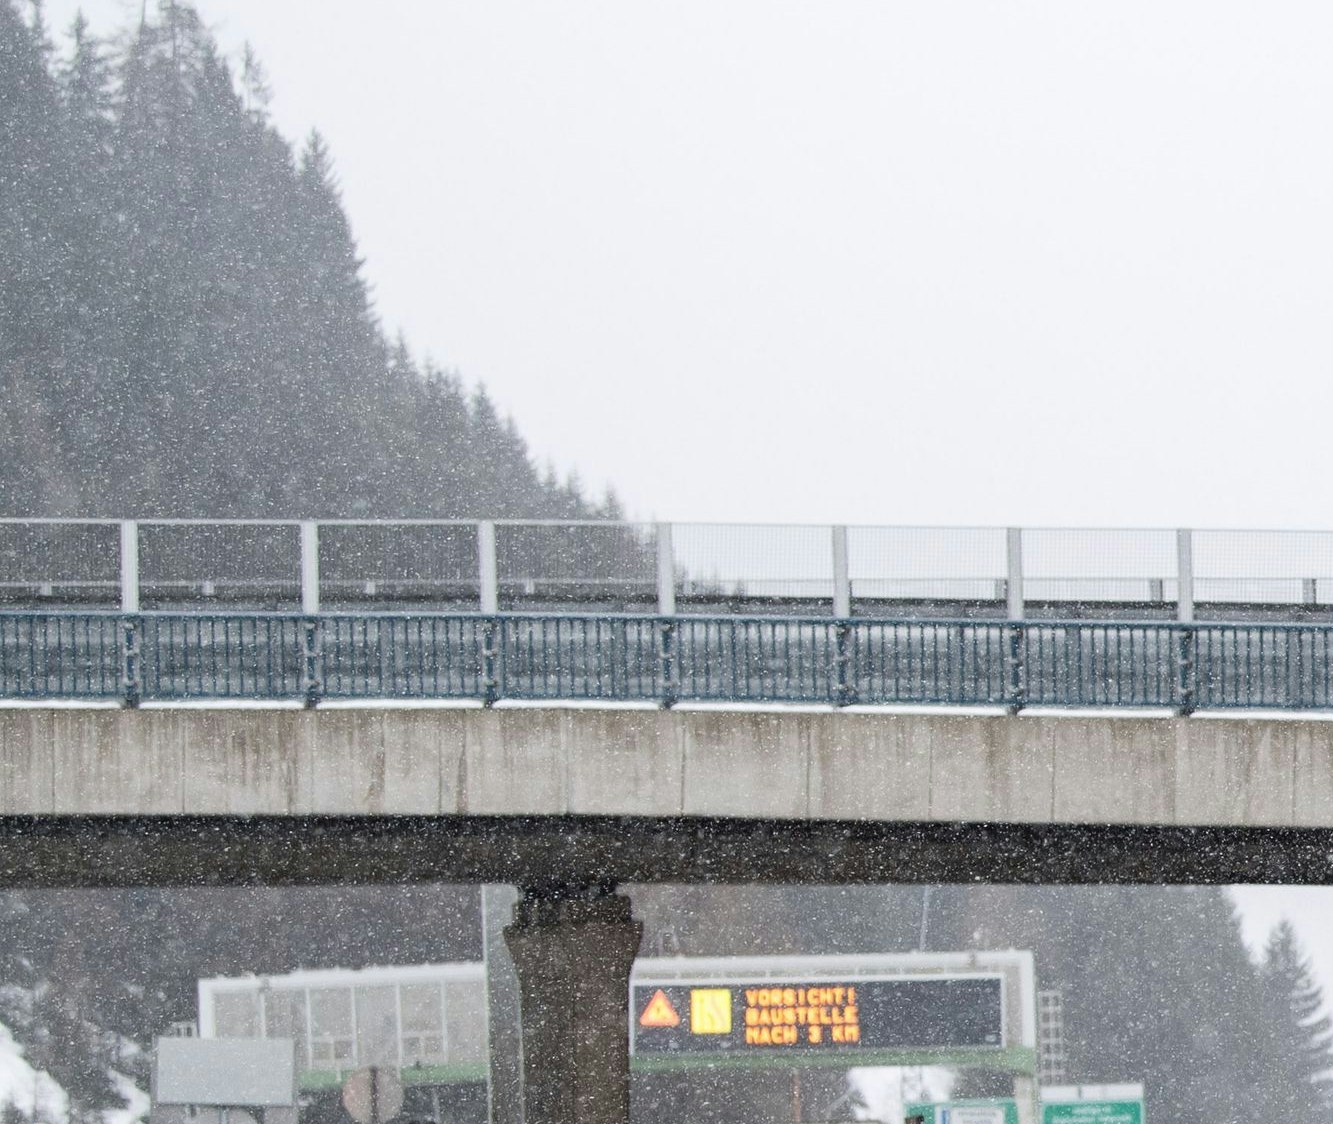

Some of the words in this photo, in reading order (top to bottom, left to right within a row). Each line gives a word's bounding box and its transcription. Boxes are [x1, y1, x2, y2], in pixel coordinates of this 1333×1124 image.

[745, 1005, 859, 1025] BAUSTELLE
[745, 1025, 798, 1045] NACH
[832, 1023, 860, 1043] KM
